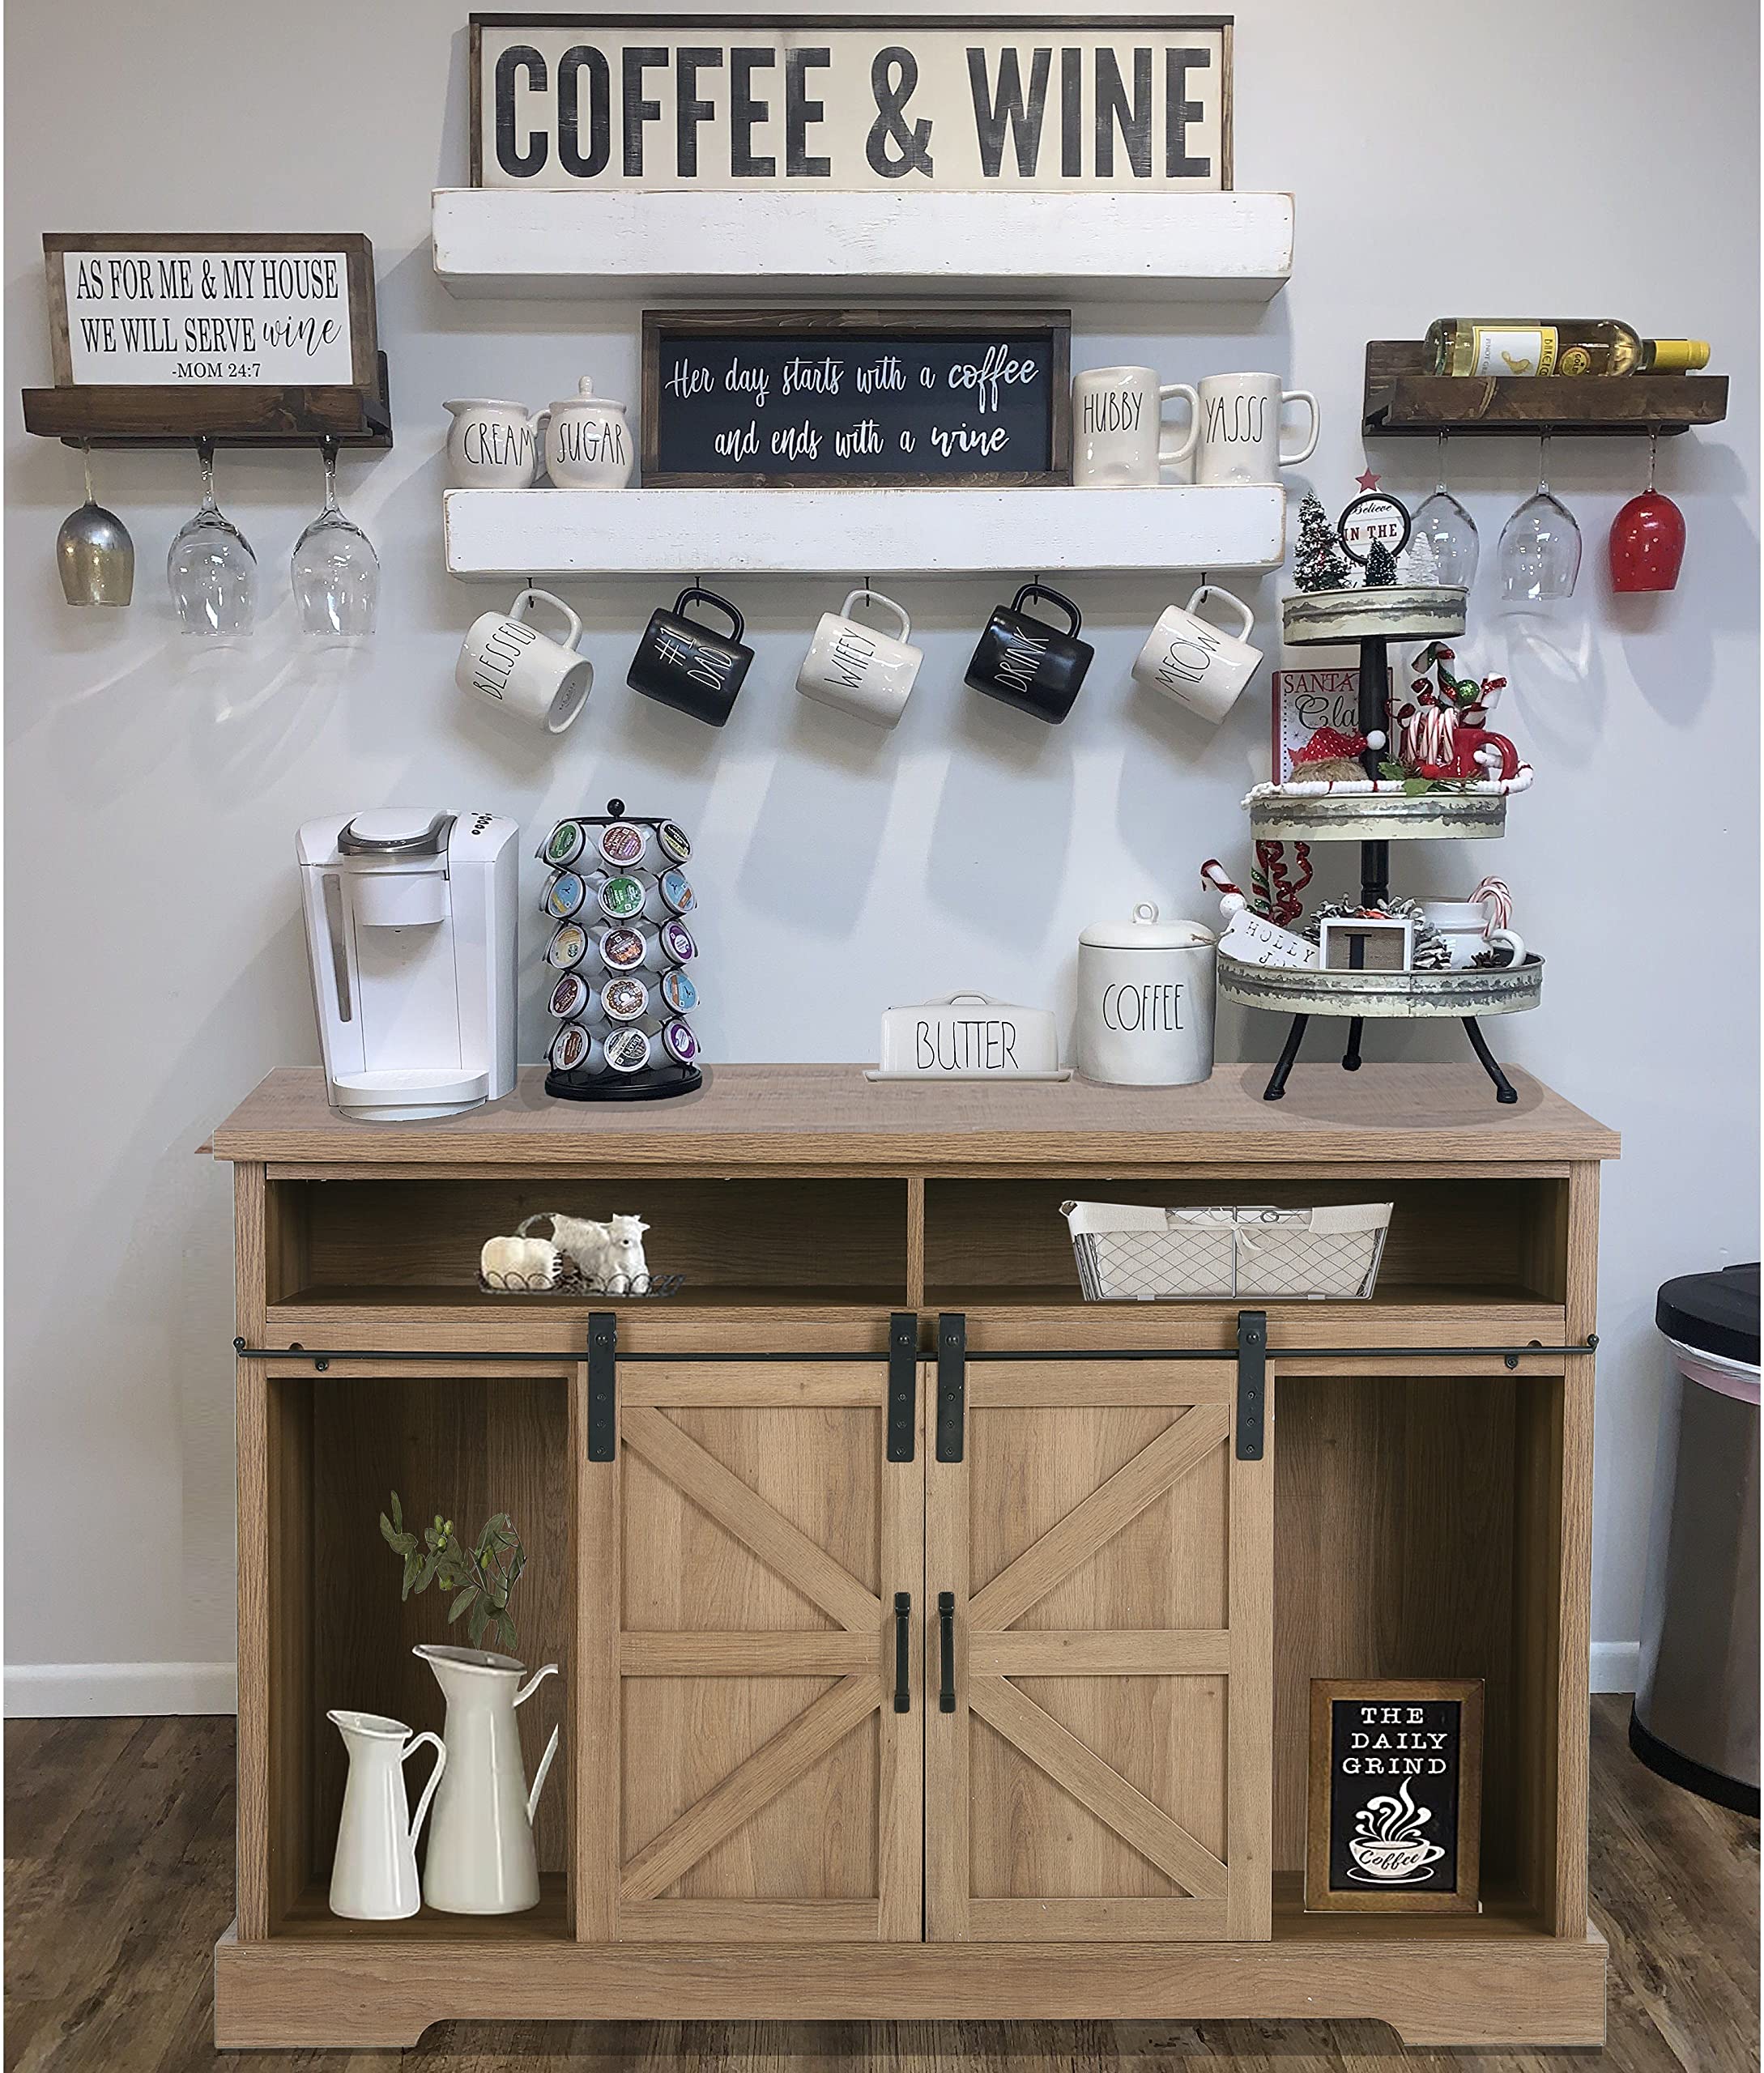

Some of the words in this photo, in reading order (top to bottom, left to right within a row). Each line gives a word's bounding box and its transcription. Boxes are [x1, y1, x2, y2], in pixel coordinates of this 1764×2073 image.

[494, 45, 831, 178] COFFEE
[865, 45, 932, 178] &
[966, 47, 1211, 177] WINE
[77, 259, 104, 300] AS
[109, 259, 154, 300] FOR
[159, 259, 194, 299] ME
[202, 259, 218, 300] &
[221, 259, 255, 299] MY
[261, 259, 339, 300] HOUSE
[79, 317, 117, 353] WE
[120, 317, 178, 352] WILL
[185, 317, 256, 352] SERVE
[262, 315, 341, 356] wine
[172, 363, 223, 378] -MOM
[228, 363, 261, 378] 24:7
[665, 358, 714, 398] Her
[725, 357, 769, 407] day
[782, 356, 845, 396] starts
[856, 355, 906, 395] with
[920, 365, 935, 387] a
[948, 343, 1040, 414] coffee
[1084, 392, 1143, 434] HUBBY
[1205, 395, 1268, 443] YASSS
[464, 422, 535, 469] CREAM
[556, 421, 625, 466] SUGAR
[714, 420, 760, 462] and
[771, 419, 823, 461] ends
[835, 419, 884, 459] with
[900, 432, 916, 453] a
[931, 421, 1010, 458] wine
[1349, 502, 1392, 515] Believe
[1344, 527, 1360, 541] IN
[1367, 523, 1397, 538] THE
[472, 622, 537, 700] BLESSED
[654, 626, 697, 666] #1
[824, 627, 876, 689] WIFEY
[994, 626, 1050, 692] DRINK
[1154, 619, 1221, 702] MEOW
[687, 646, 732, 691] DAD
[1284, 673, 1354, 694] SANTA
[1295, 694, 1359, 730] Cla
[1246, 921, 1315, 964] HOLLY
[1102, 984, 1184, 1031] COFFEE
[917, 1020, 1019, 1071] BUTTER
[1361, 1707, 1424, 1724] THE
[1351, 1733, 1448, 1749] DAILY
[1342, 1758, 1447, 1774] GRIND
[1359, 1850, 1421, 1871] Coffee
